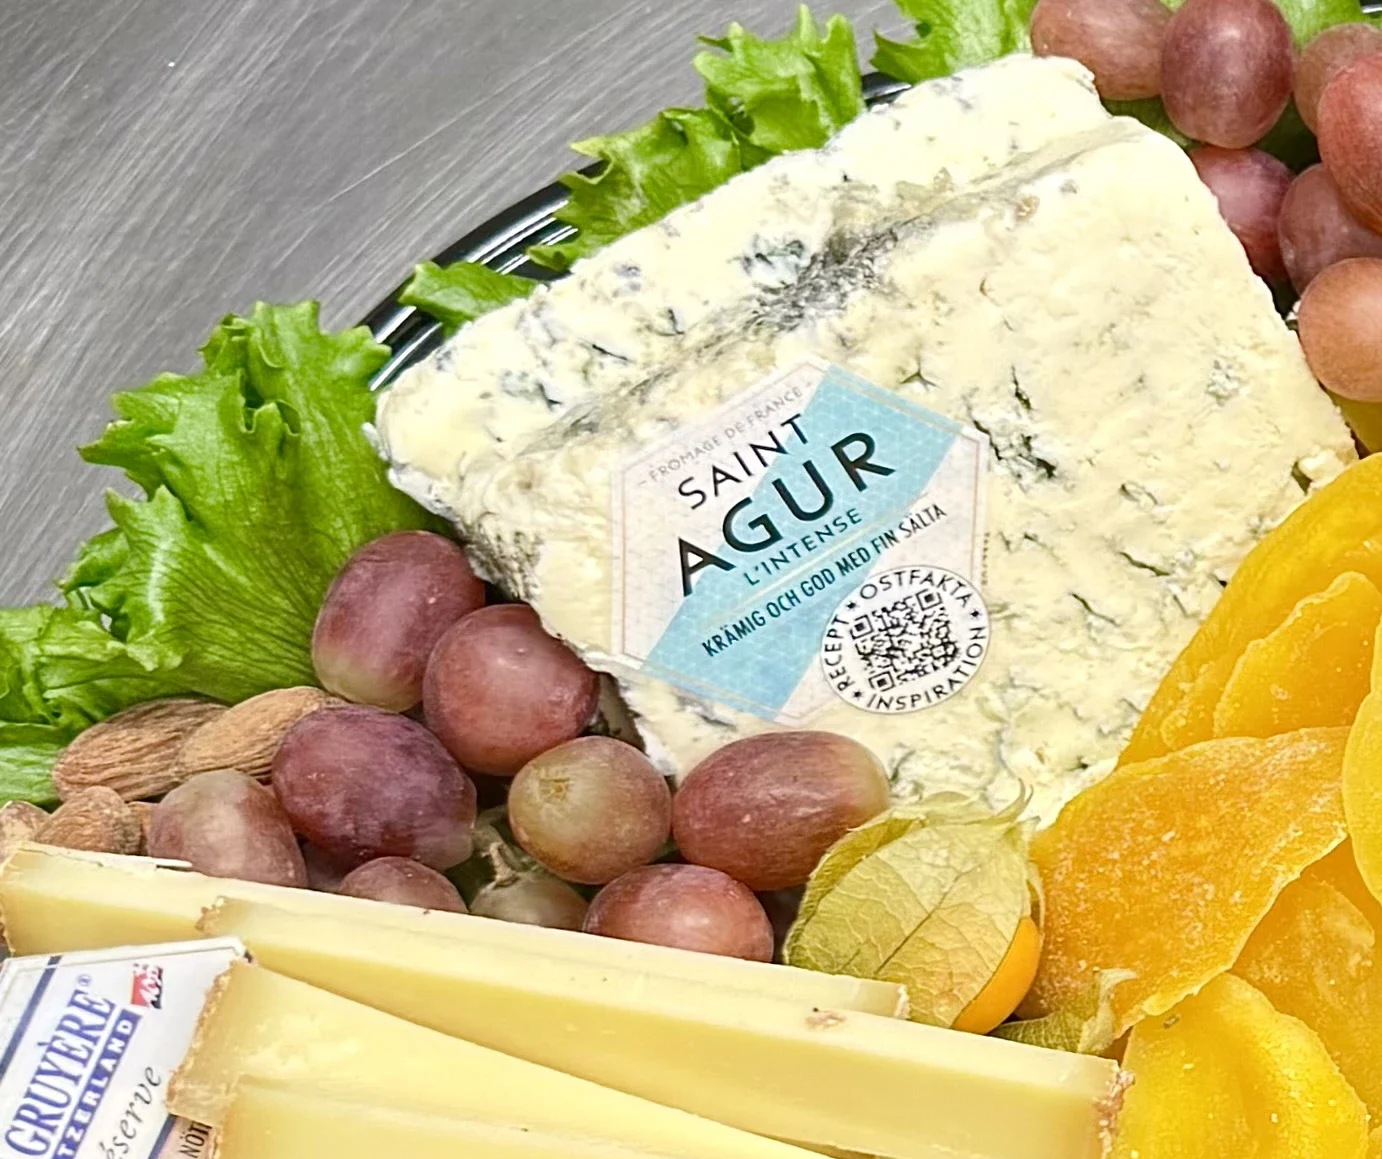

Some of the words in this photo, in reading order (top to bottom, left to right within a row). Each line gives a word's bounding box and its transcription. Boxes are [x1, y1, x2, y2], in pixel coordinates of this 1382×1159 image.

[648, 436, 722, 481] FROMAGE
[725, 421, 746, 438] DE
[746, 387, 804, 429] FRANCE
[678, 412, 811, 510] SAINT
[677, 432, 895, 597] AGUR
[744, 507, 863, 586] L'INTENSE
[702, 610, 767, 657] KRÄMIG
[767, 590, 801, 618] OCH
[801, 569, 836, 600] GOD
[839, 548, 872, 580] MED
[871, 528, 899, 556] FIN
[899, 503, 948, 539] SÄLTA
[824, 615, 852, 692] RECEPT
[860, 568, 974, 609] OSTFAKTA
[867, 625, 987, 712] INSPIRATION
